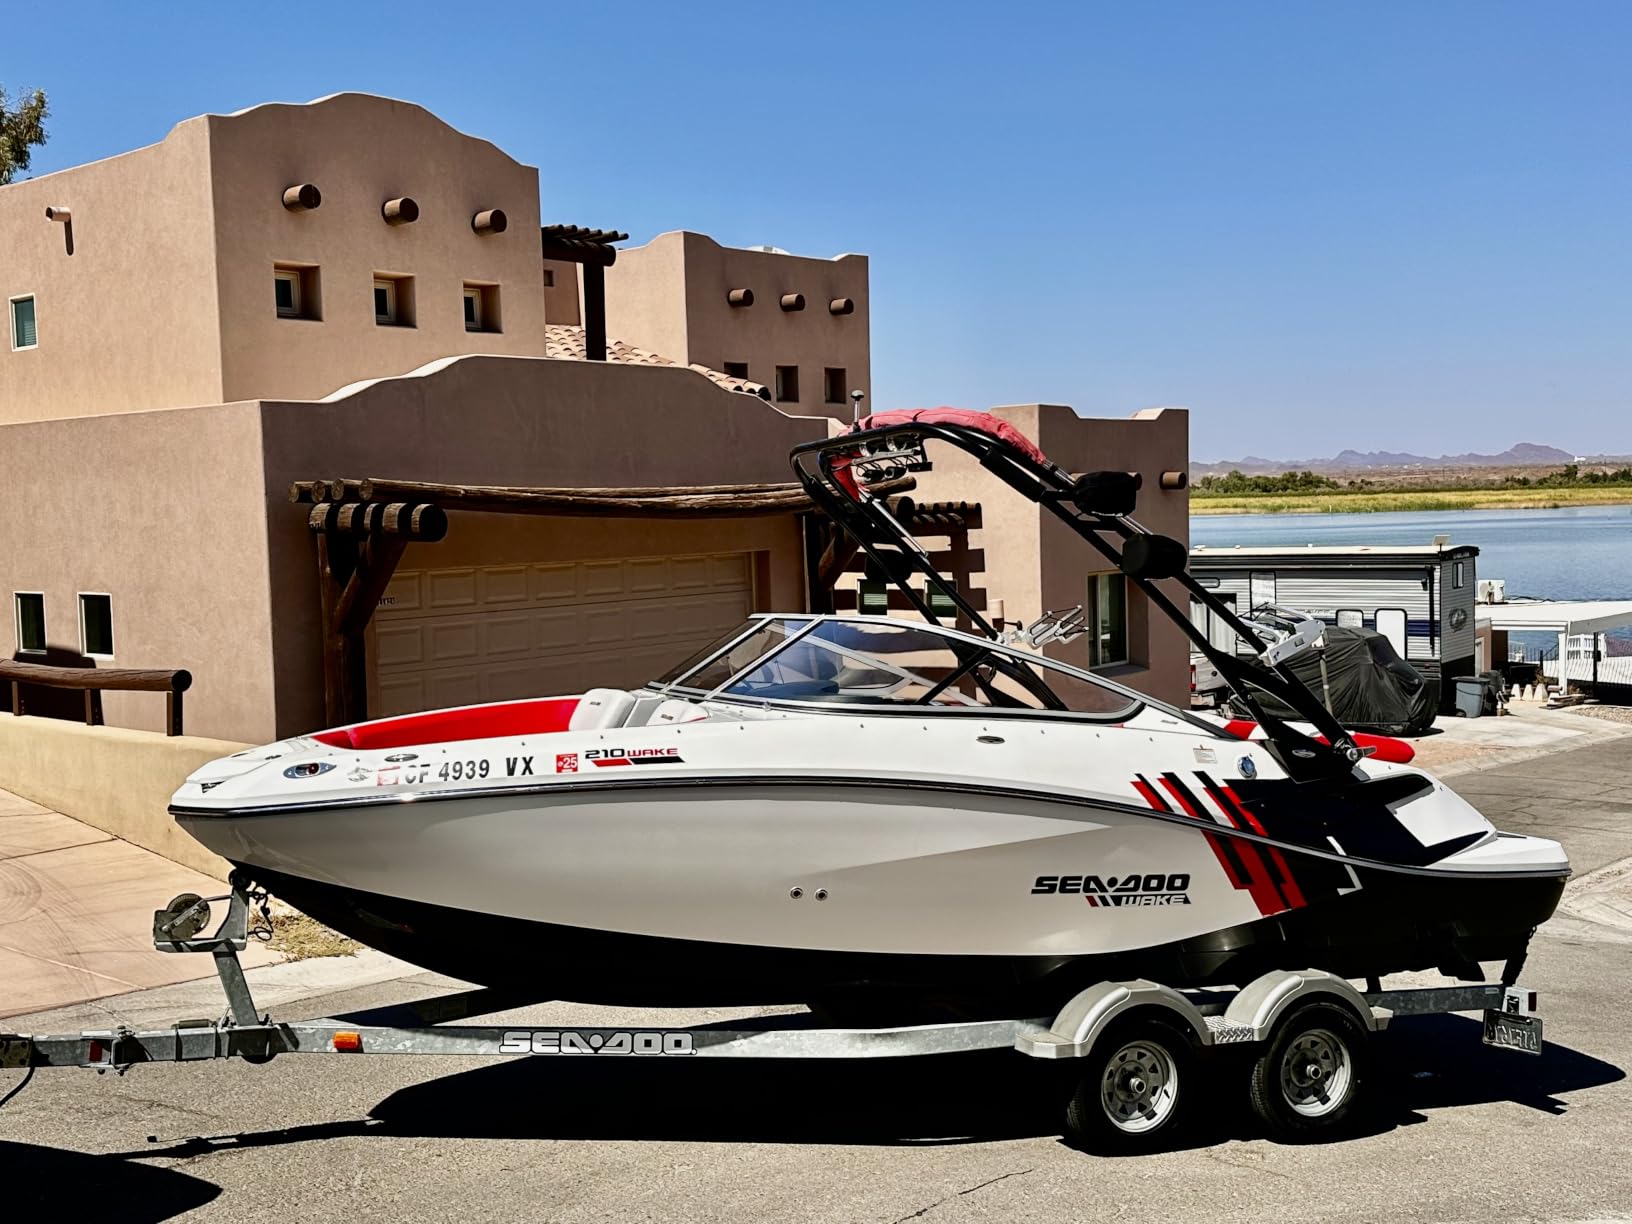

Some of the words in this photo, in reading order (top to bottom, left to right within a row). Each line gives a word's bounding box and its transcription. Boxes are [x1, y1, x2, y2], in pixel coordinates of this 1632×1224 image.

[584, 748, 625, 760] 210
[627, 747, 678, 757] WAKE
[404, 763, 432, 784] CF
[438, 758, 490, 783] 4939
[505, 755, 535, 777] VX
[1120, 894, 1186, 907] WAKE
